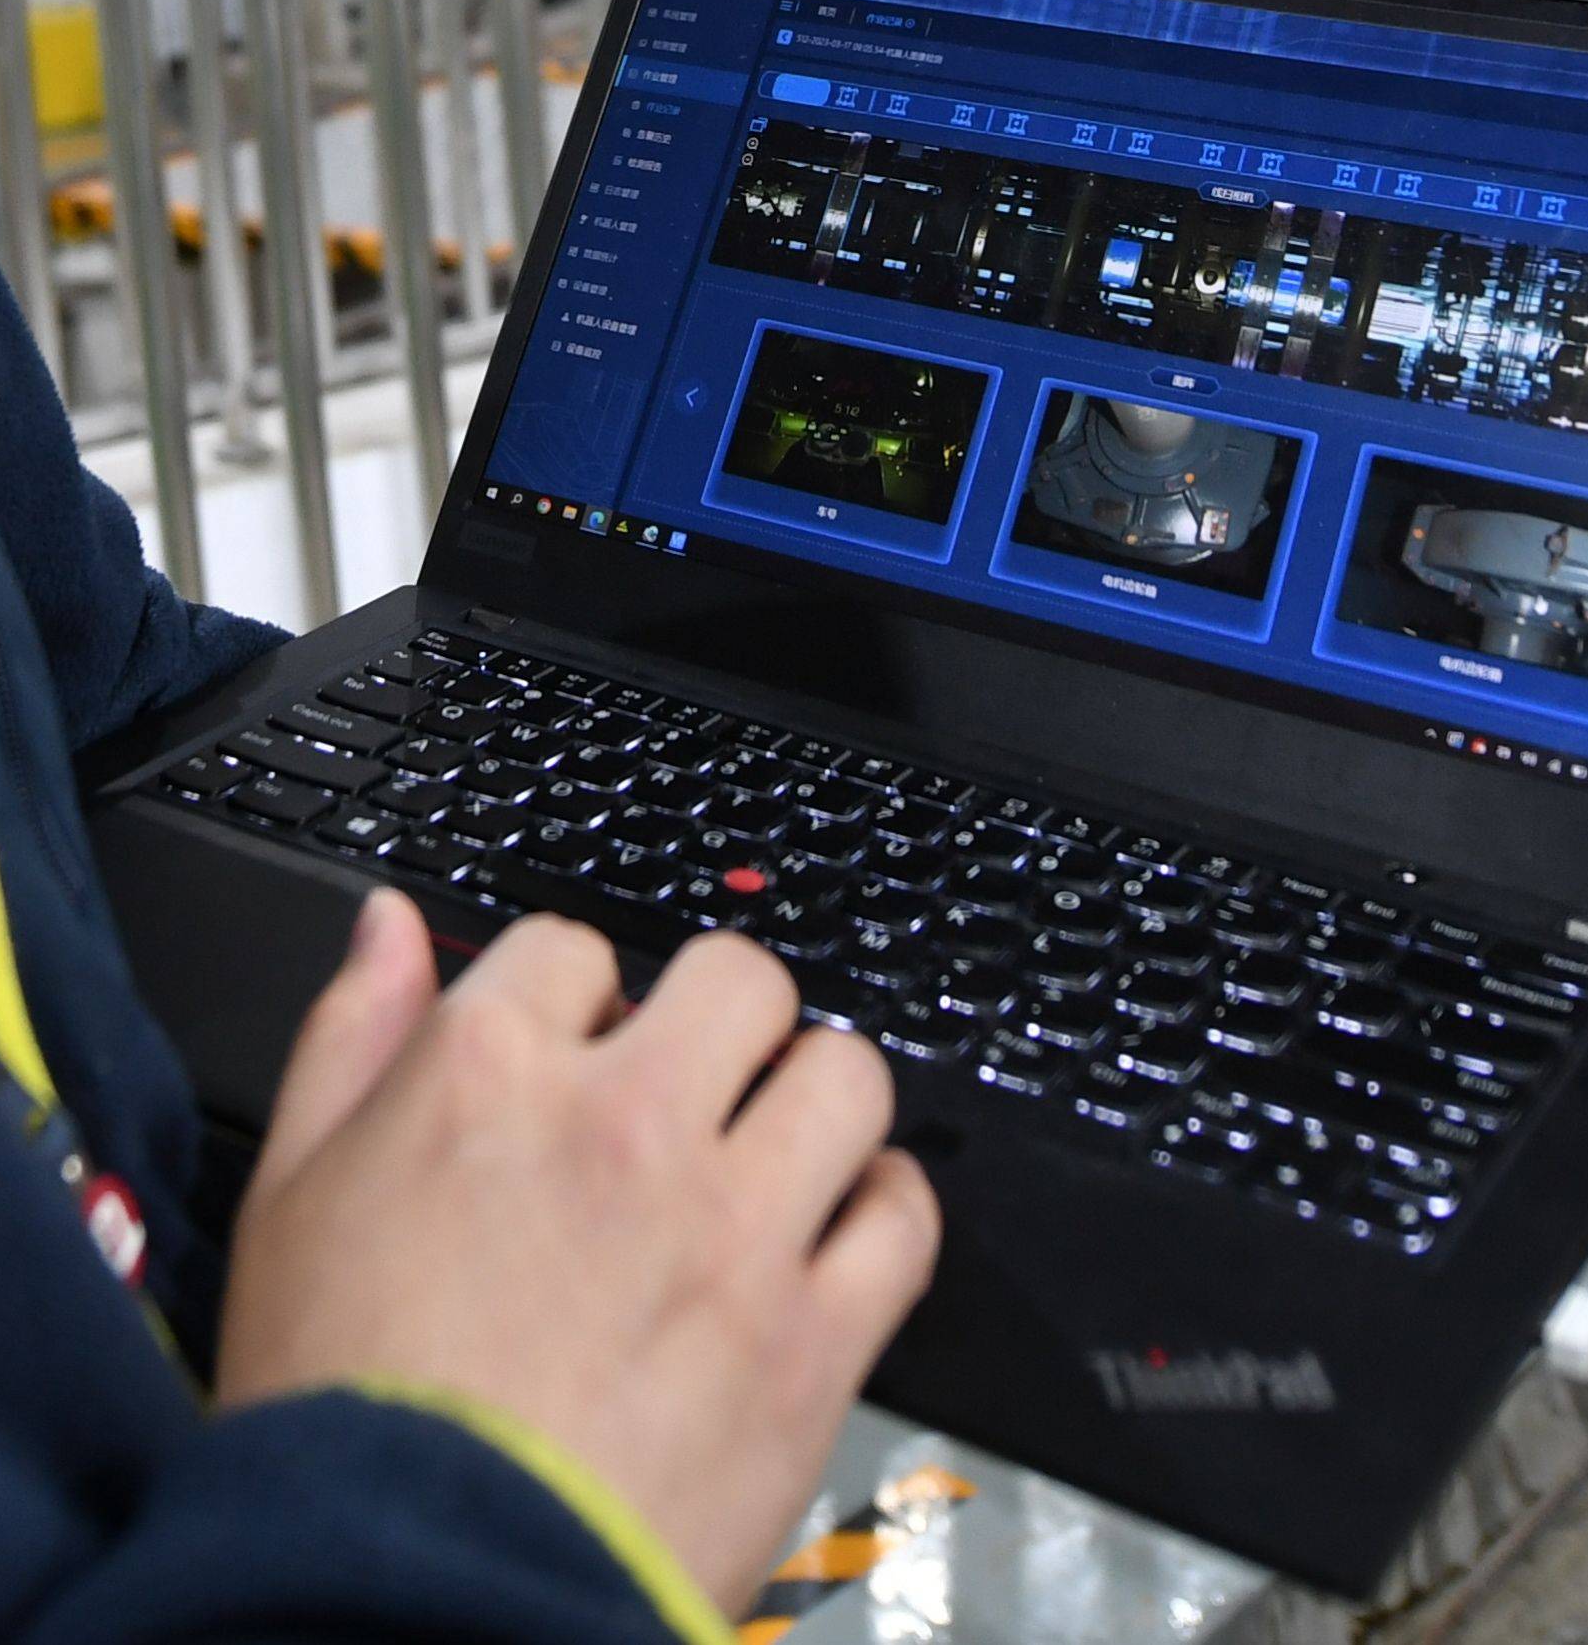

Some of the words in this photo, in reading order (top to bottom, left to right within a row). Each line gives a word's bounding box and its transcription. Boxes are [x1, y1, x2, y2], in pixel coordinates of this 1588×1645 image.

[441, 705, 464, 719] Q
[575, 717, 594, 730] 3
[511, 725, 540, 742] W
[408, 738, 429, 753] A
[780, 854, 809, 873] H
[1053, 890, 1082, 911] O
[774, 900, 804, 921] N
[945, 905, 974, 926] K
[859, 927, 892, 951] M
